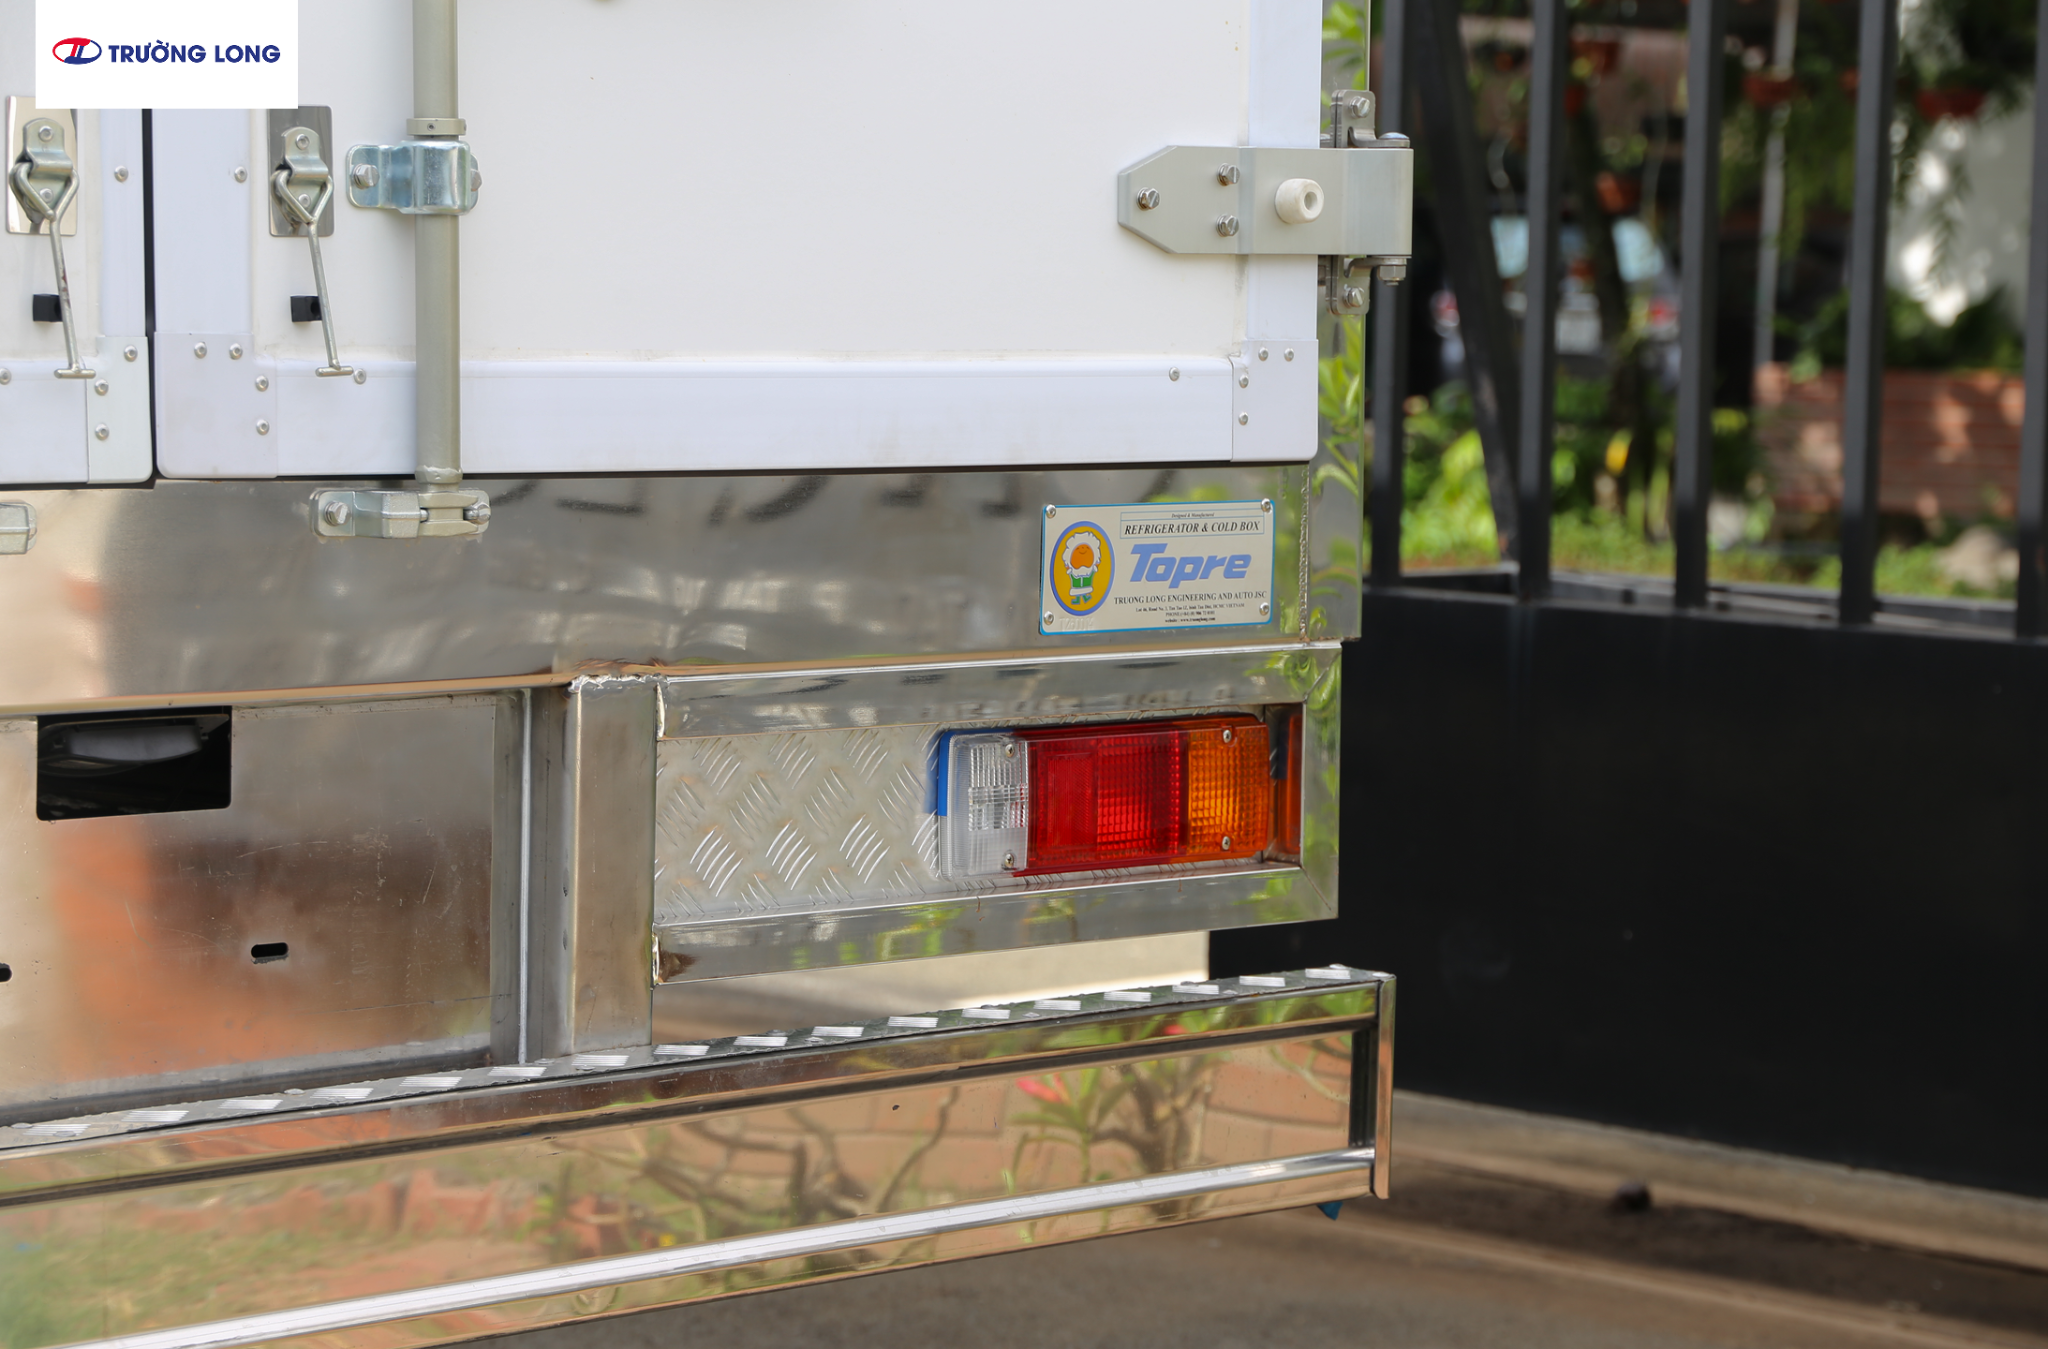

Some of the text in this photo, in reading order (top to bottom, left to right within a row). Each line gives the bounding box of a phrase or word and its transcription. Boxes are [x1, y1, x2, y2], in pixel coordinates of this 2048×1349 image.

[1124, 520, 1261, 536] REFRIGERATOR & COLD BOX
[1130, 543, 1252, 589] Topre
[1114, 590, 1268, 605] TRUONG LONG ENGINEERING AND AUTO JSC
